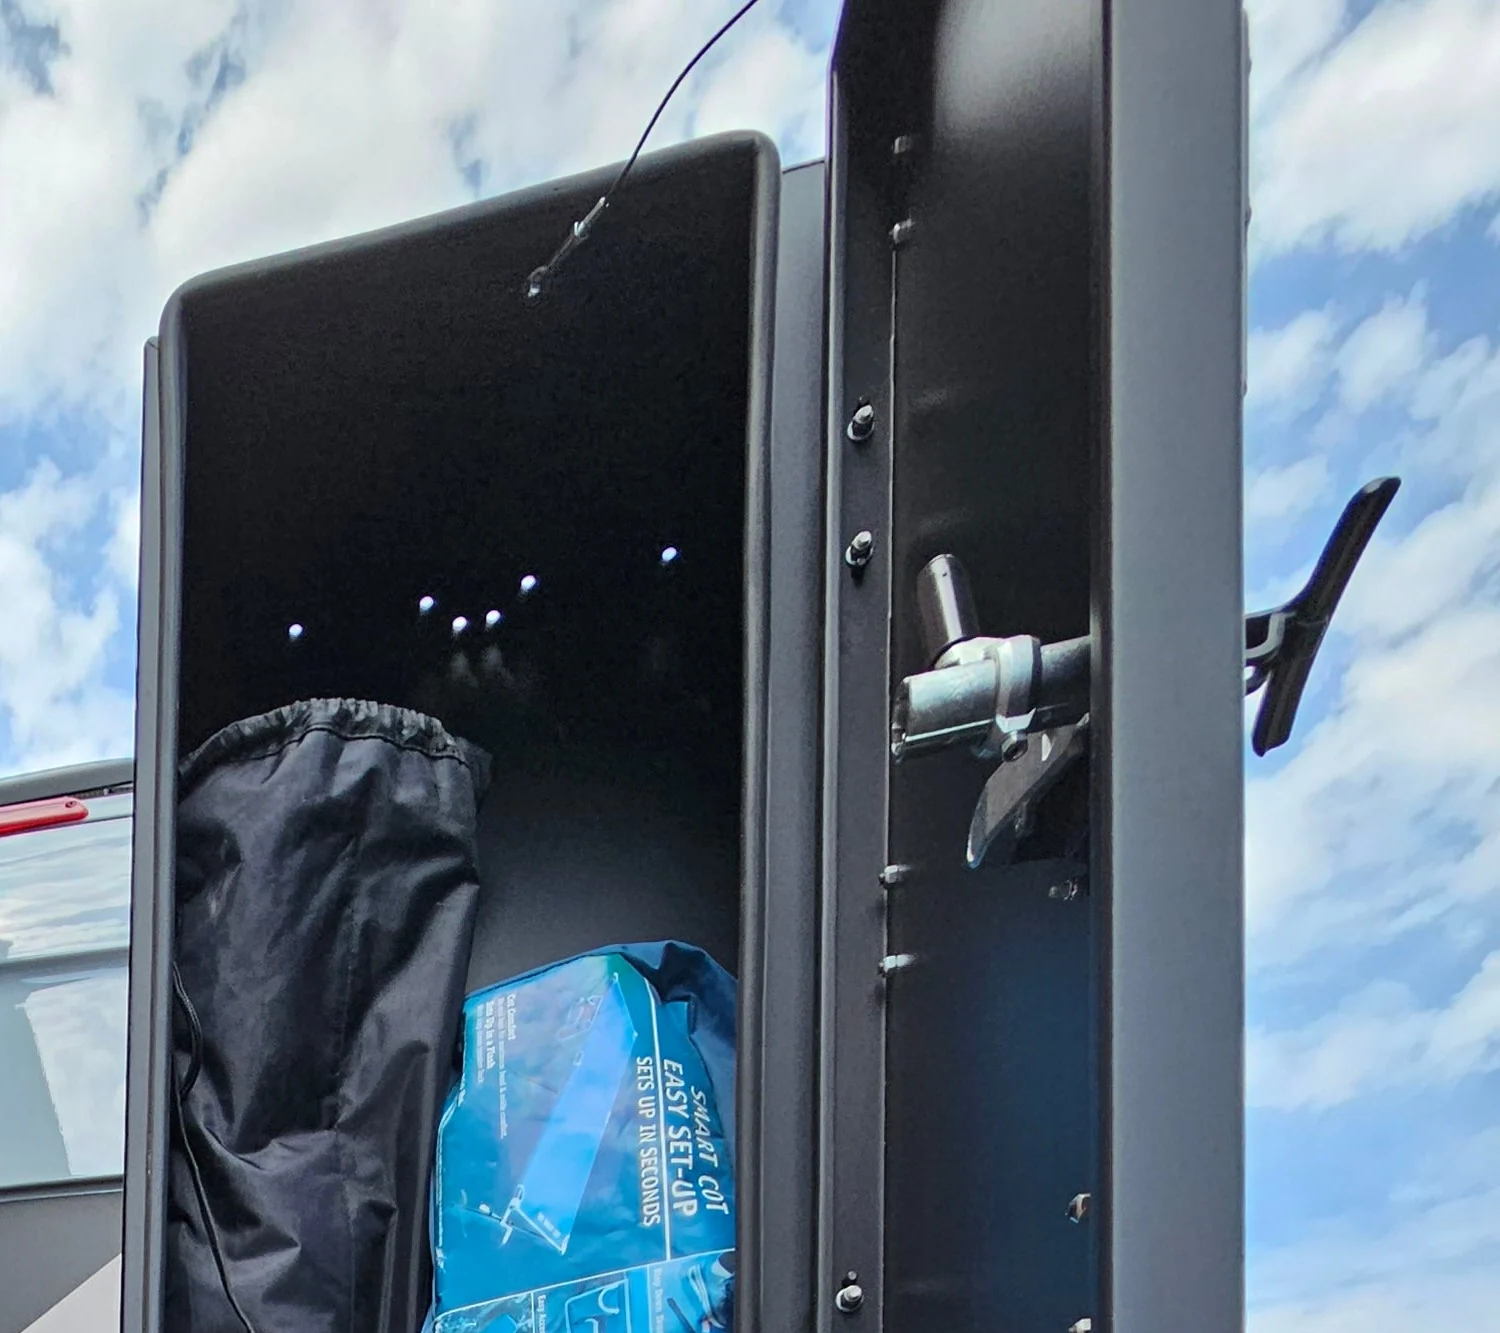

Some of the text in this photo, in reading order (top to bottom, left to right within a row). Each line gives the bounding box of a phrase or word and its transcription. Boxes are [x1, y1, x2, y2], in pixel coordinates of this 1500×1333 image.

[636, 1056, 660, 1227] SETS UP IN SECONDS
[663, 1059, 697, 1216] EASY SET-UP
[691, 1086, 729, 1214] SMART COT
[536, 1294, 546, 1312] Easy
